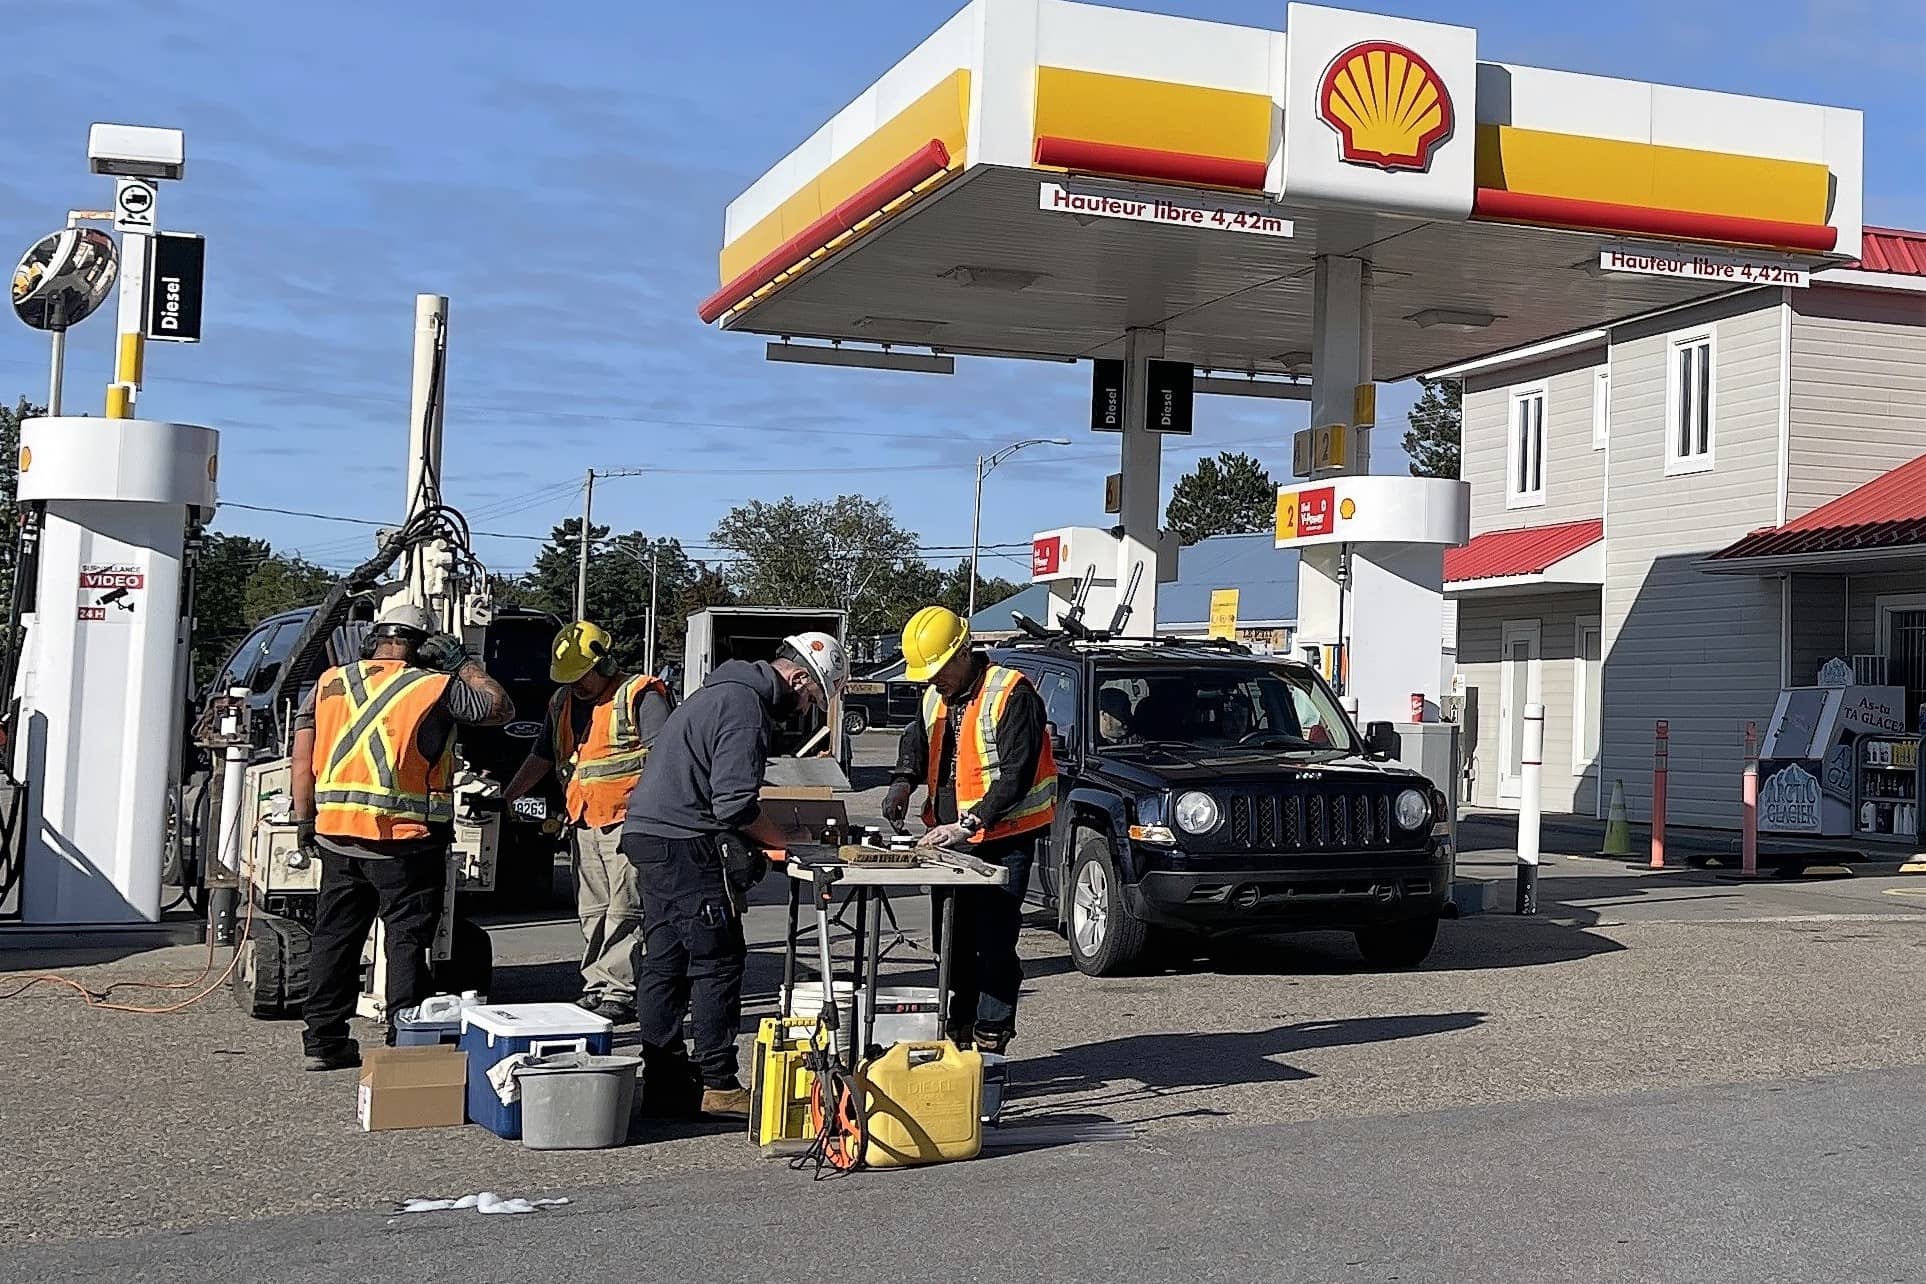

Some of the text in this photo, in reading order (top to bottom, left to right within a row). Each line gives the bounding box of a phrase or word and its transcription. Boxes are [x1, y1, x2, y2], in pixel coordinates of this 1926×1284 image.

[1053, 189, 1282, 232] Hauteur libre 4,42m
[1611, 251, 1799, 284] Hauteur libre 4,42m
[161, 277, 180, 329] Diesel
[1105, 388, 1117, 424] Diesel
[1161, 389, 1173, 425] Diesel
[1322, 431, 1330, 461] 2
[1287, 504, 1294, 528] 2
[86, 575, 140, 587] VIDEO
[1844, 707, 1858, 721] TA
[1764, 776, 1817, 804] ARCTIC
[1766, 803, 1817, 825] GLACIER
